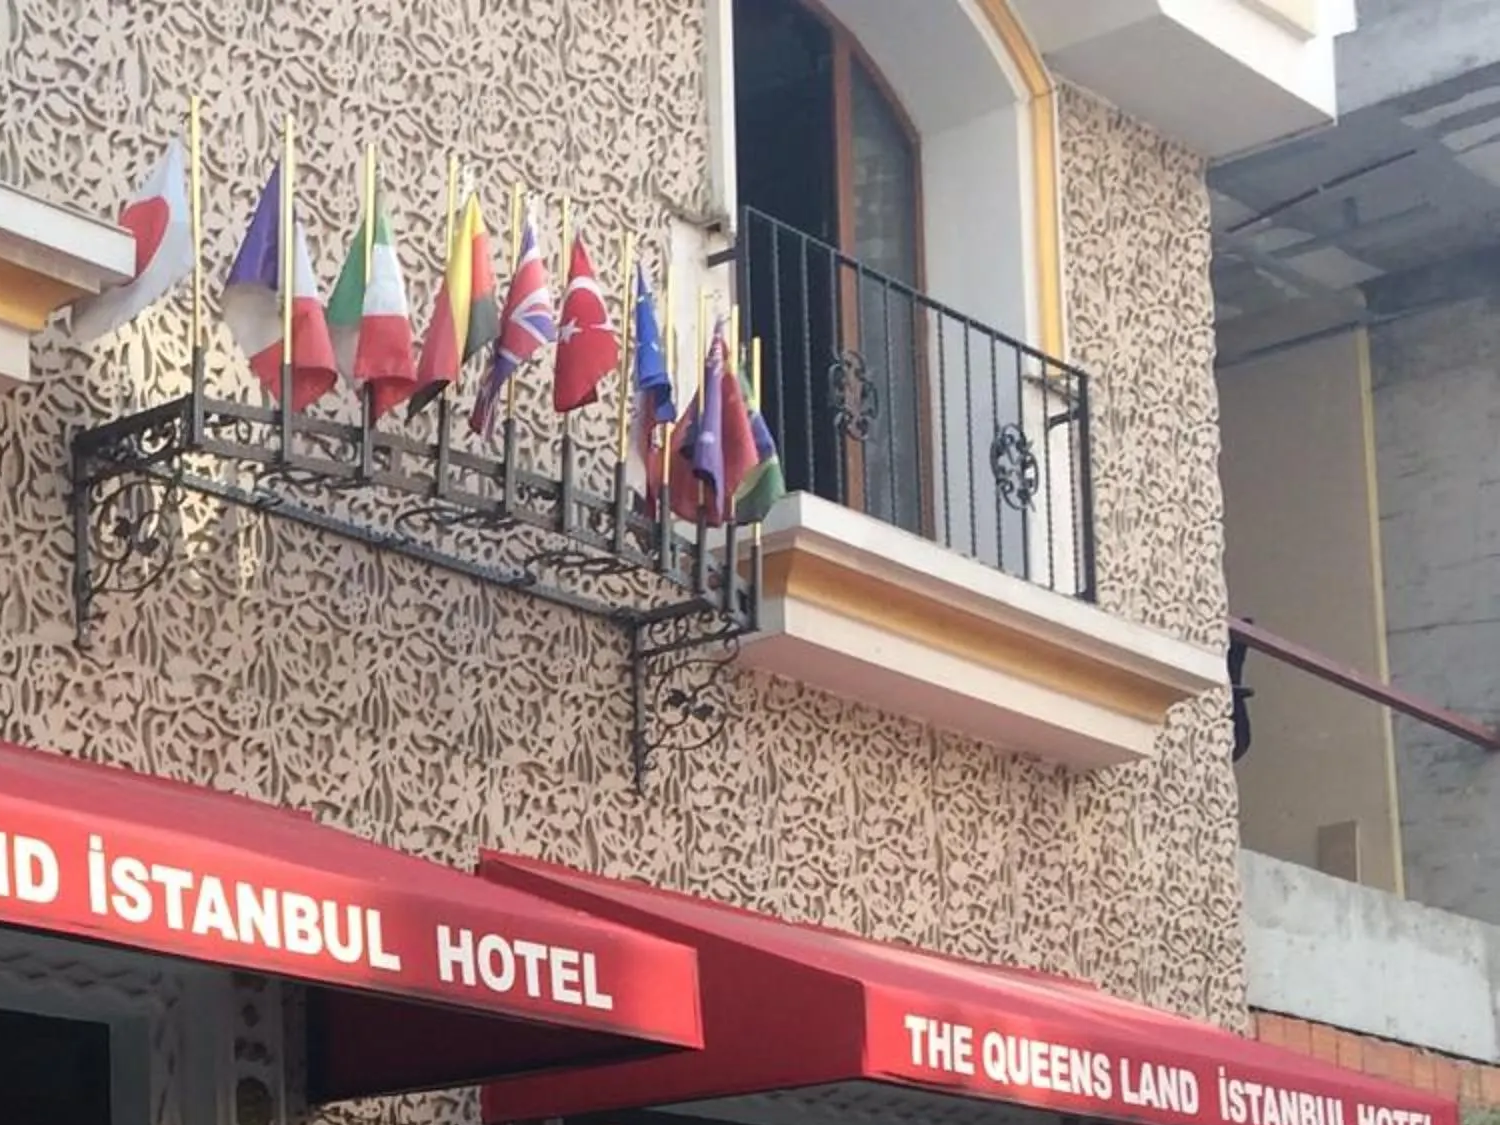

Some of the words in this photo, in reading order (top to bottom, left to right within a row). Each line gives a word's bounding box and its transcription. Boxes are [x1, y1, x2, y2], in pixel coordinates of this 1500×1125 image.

[88, 834, 401, 972] İSTANBUL
[437, 925, 613, 1011] HOTEL
[904, 1014, 974, 1076] THE
[982, 1031, 1112, 1099] QUEENS
[1120, 1059, 1199, 1114] LAND
